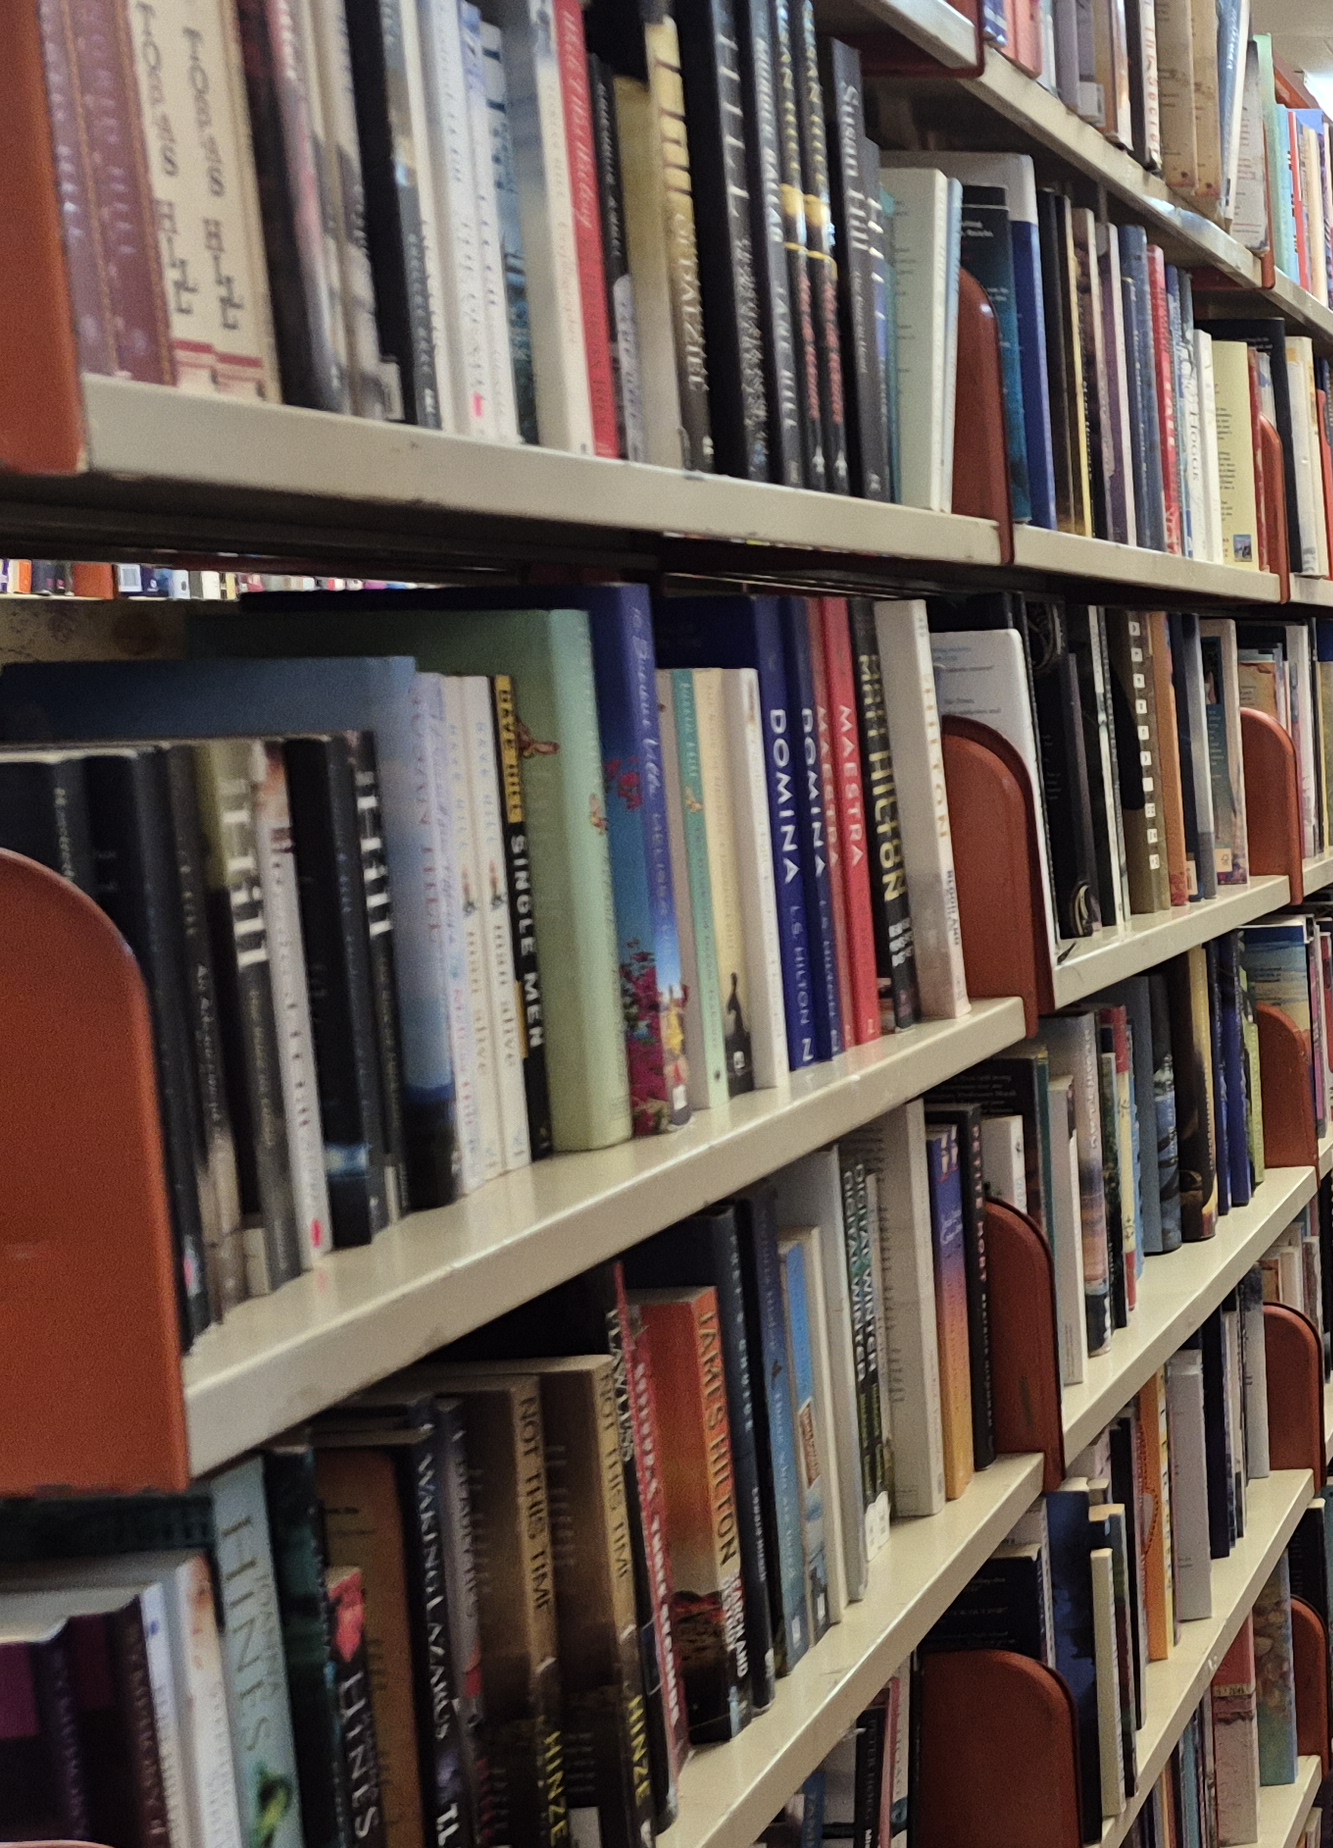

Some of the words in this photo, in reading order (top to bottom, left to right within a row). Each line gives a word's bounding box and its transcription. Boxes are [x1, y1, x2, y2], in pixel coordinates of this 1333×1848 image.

[840, 82, 862, 178] Susan
[847, 188, 869, 252] Hill
[769, 707, 800, 885] DOMINA
[801, 707, 827, 879] DOMINA
[839, 704, 865, 869] MAESTRA
[867, 750, 908, 903] HILTON
[509, 834, 536, 969] SINGLE
[523, 972, 542, 1048] MEN
[695, 1310, 727, 1432] JAMES
[850, 1271, 866, 1382] WINTER
[519, 1396, 538, 1461] NOT
[707, 1440, 738, 1567] HILTON
[543, 1730, 567, 1848] HINZE
[626, 1694, 650, 1806] HINZE
